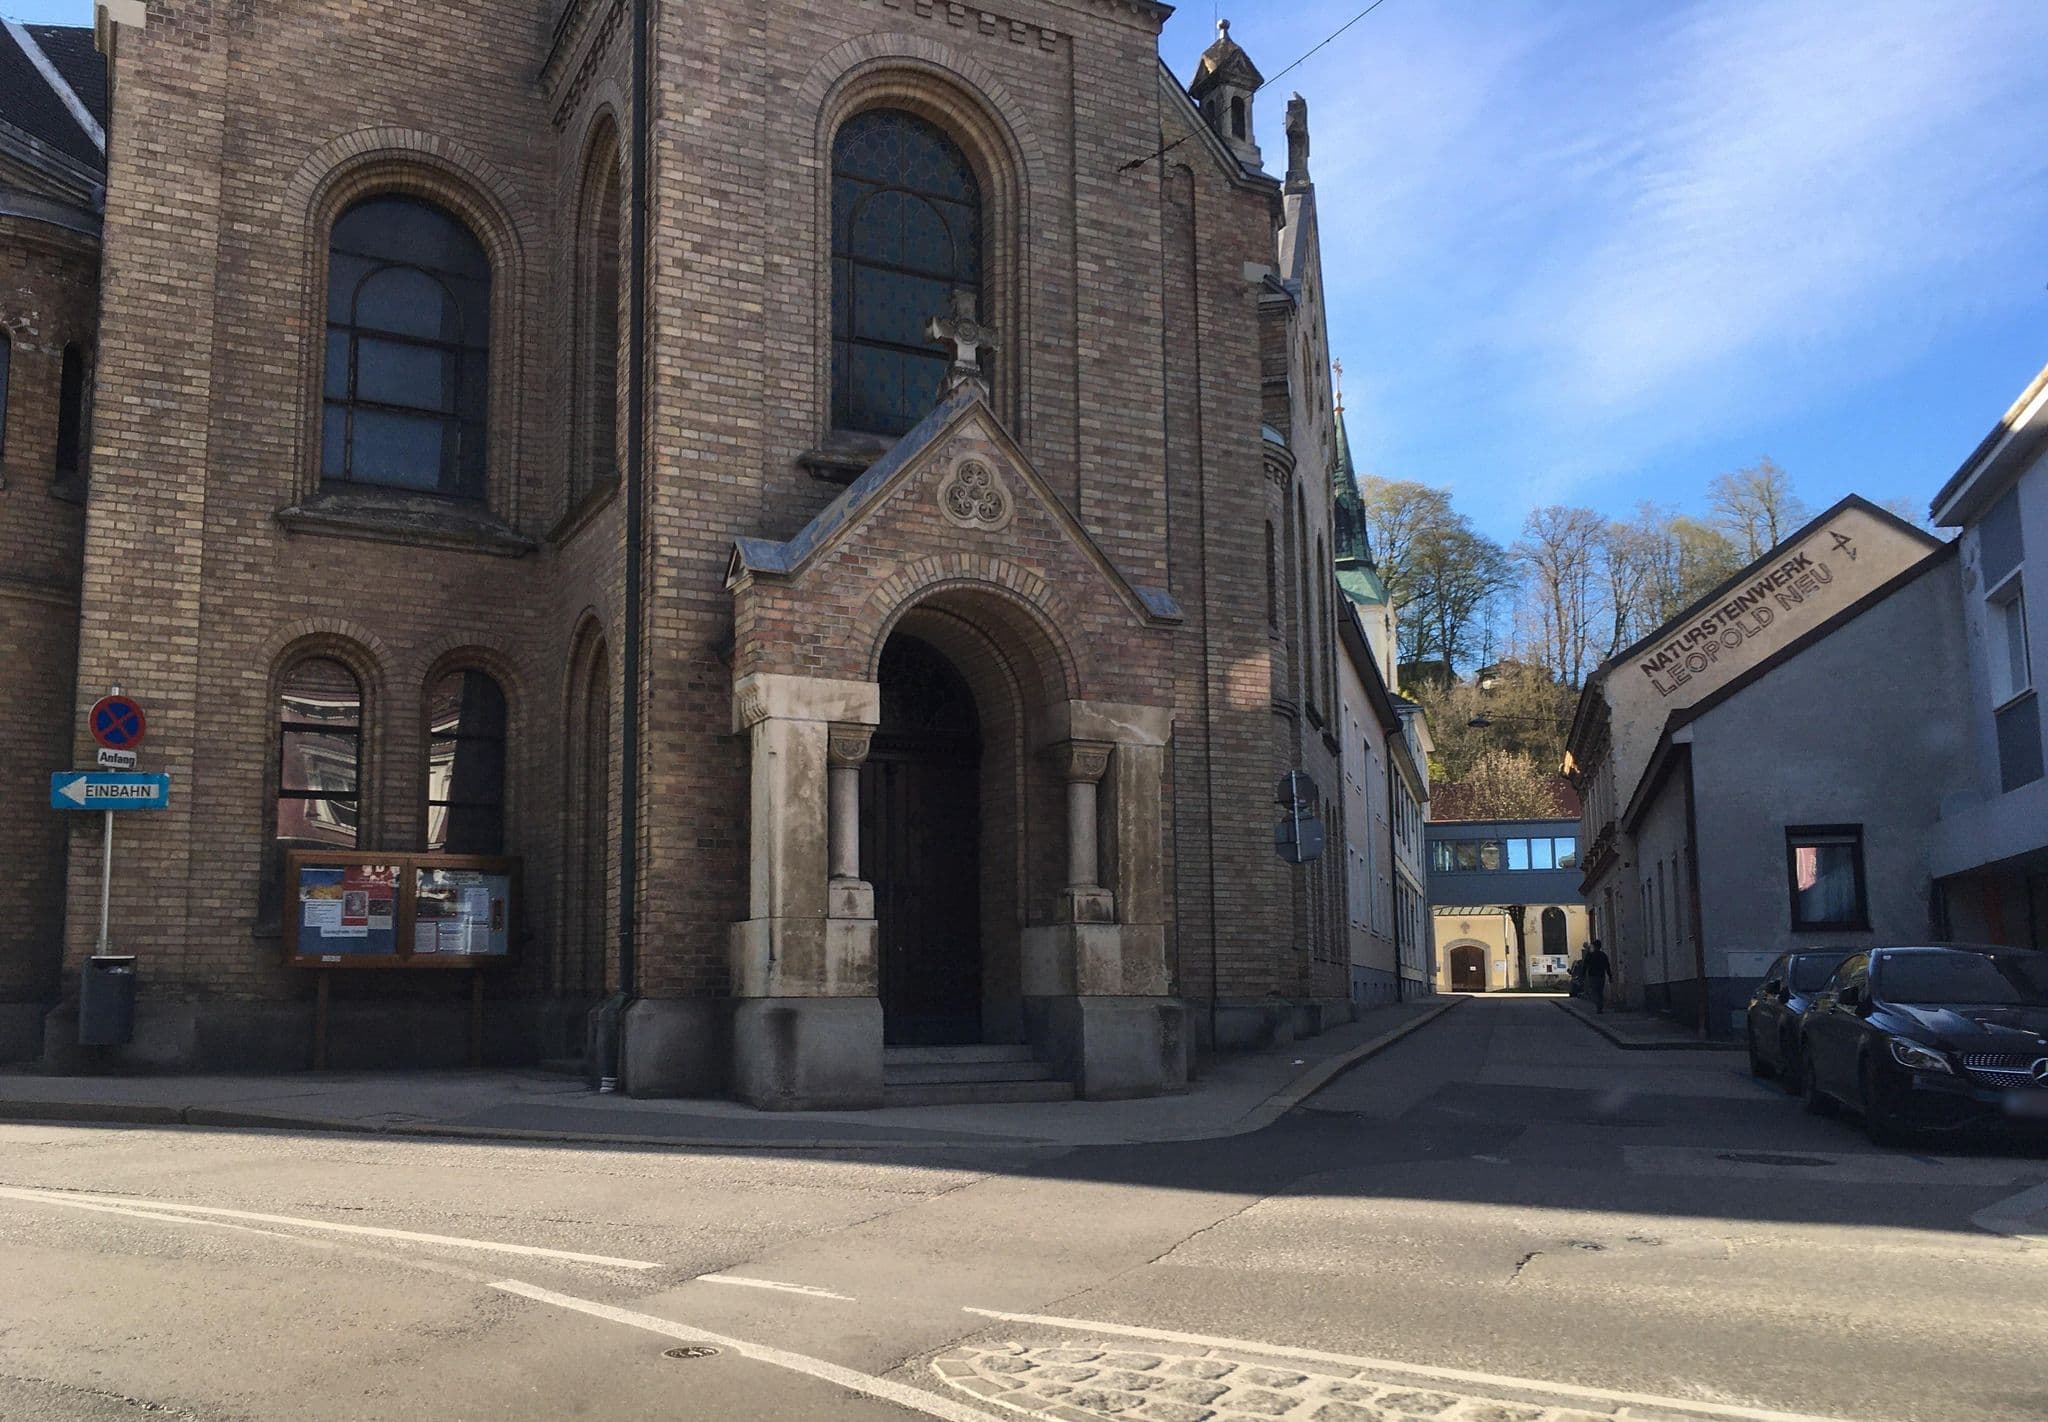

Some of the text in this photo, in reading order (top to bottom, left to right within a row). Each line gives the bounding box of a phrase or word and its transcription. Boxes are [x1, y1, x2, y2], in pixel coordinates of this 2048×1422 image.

[1640, 551, 1813, 678] NATURSTEINWERK
[1651, 563, 1833, 697] LEOPOLD NEU
[85, 785, 151, 797] EINBAHN
[100, 752, 135, 766] Anfang
